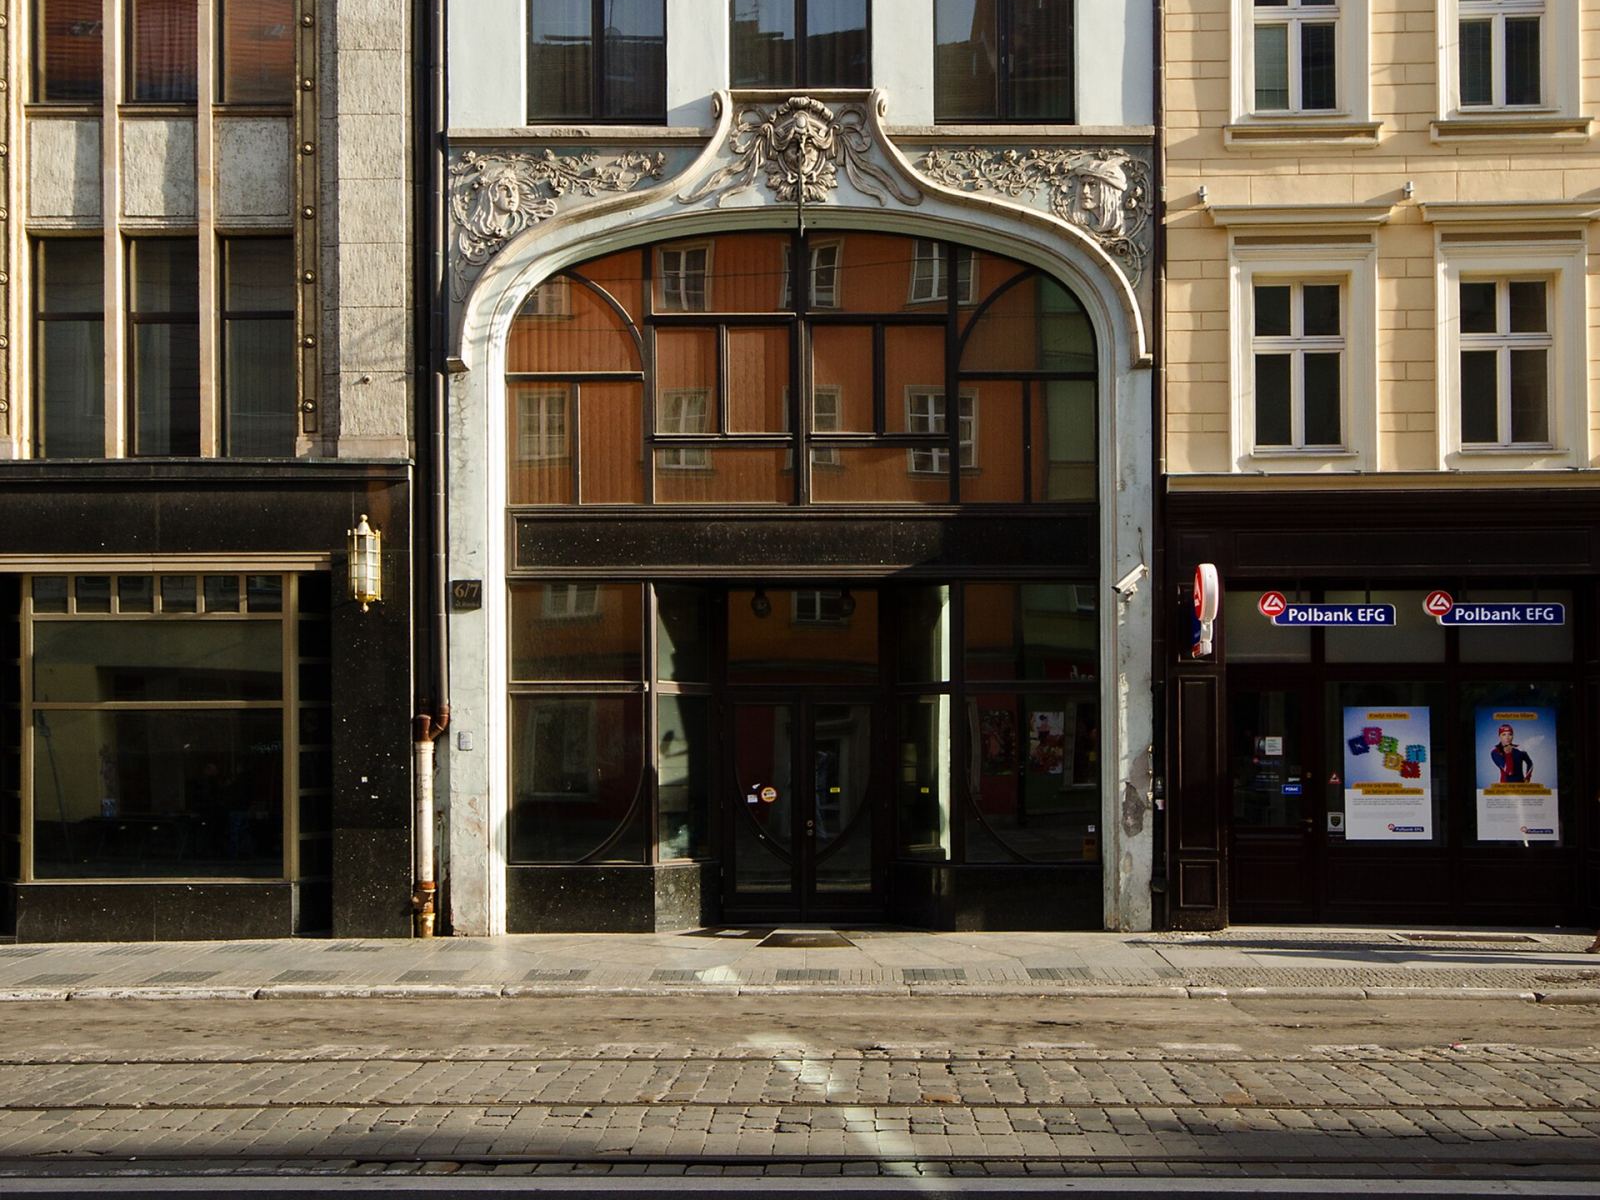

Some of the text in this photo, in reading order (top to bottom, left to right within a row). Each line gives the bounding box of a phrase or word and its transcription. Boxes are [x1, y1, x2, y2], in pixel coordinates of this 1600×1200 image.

[454, 583, 480, 598] 6/7
[1288, 608, 1385, 622] Polbank EFG
[1455, 607, 1554, 621] Polbank EFG
